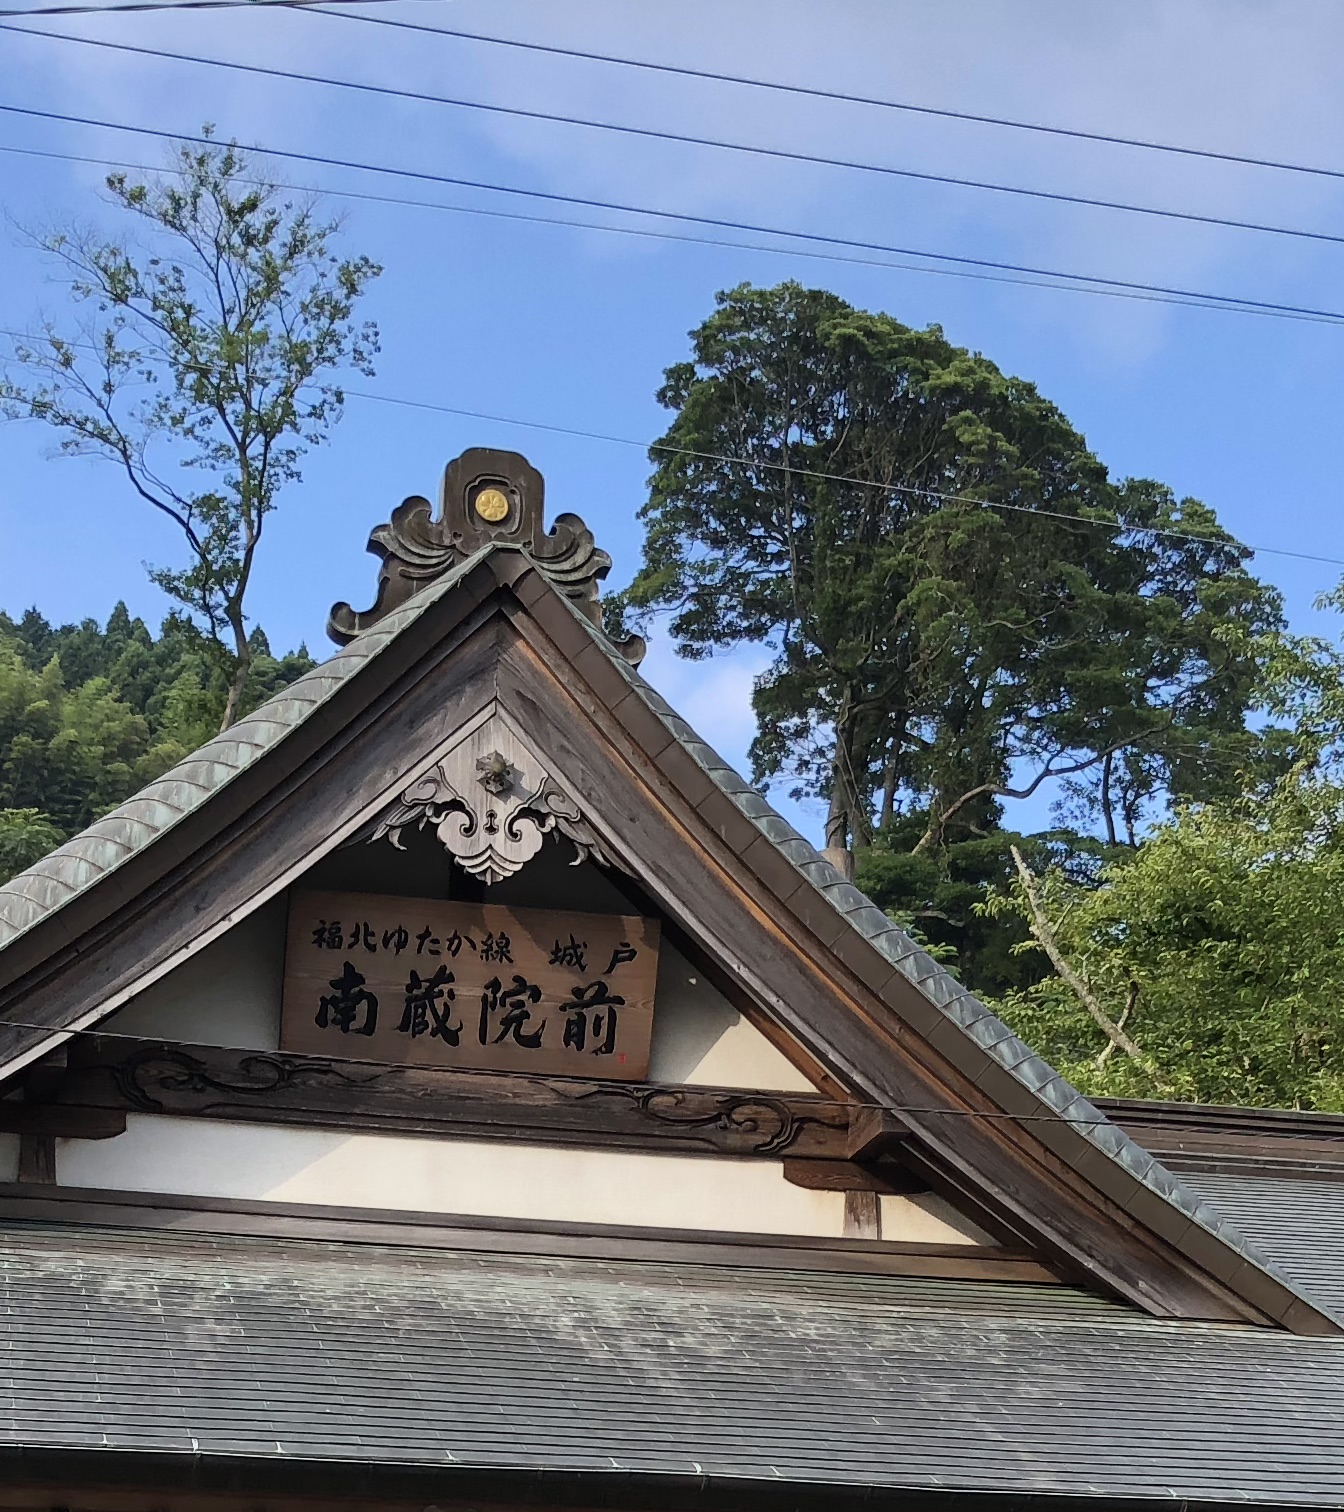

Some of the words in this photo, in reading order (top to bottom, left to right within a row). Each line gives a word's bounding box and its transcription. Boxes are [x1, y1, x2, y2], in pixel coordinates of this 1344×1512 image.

[312, 920, 515, 964] 福北ゆたか線
[314, 960, 626, 1056] 南蔵院前
